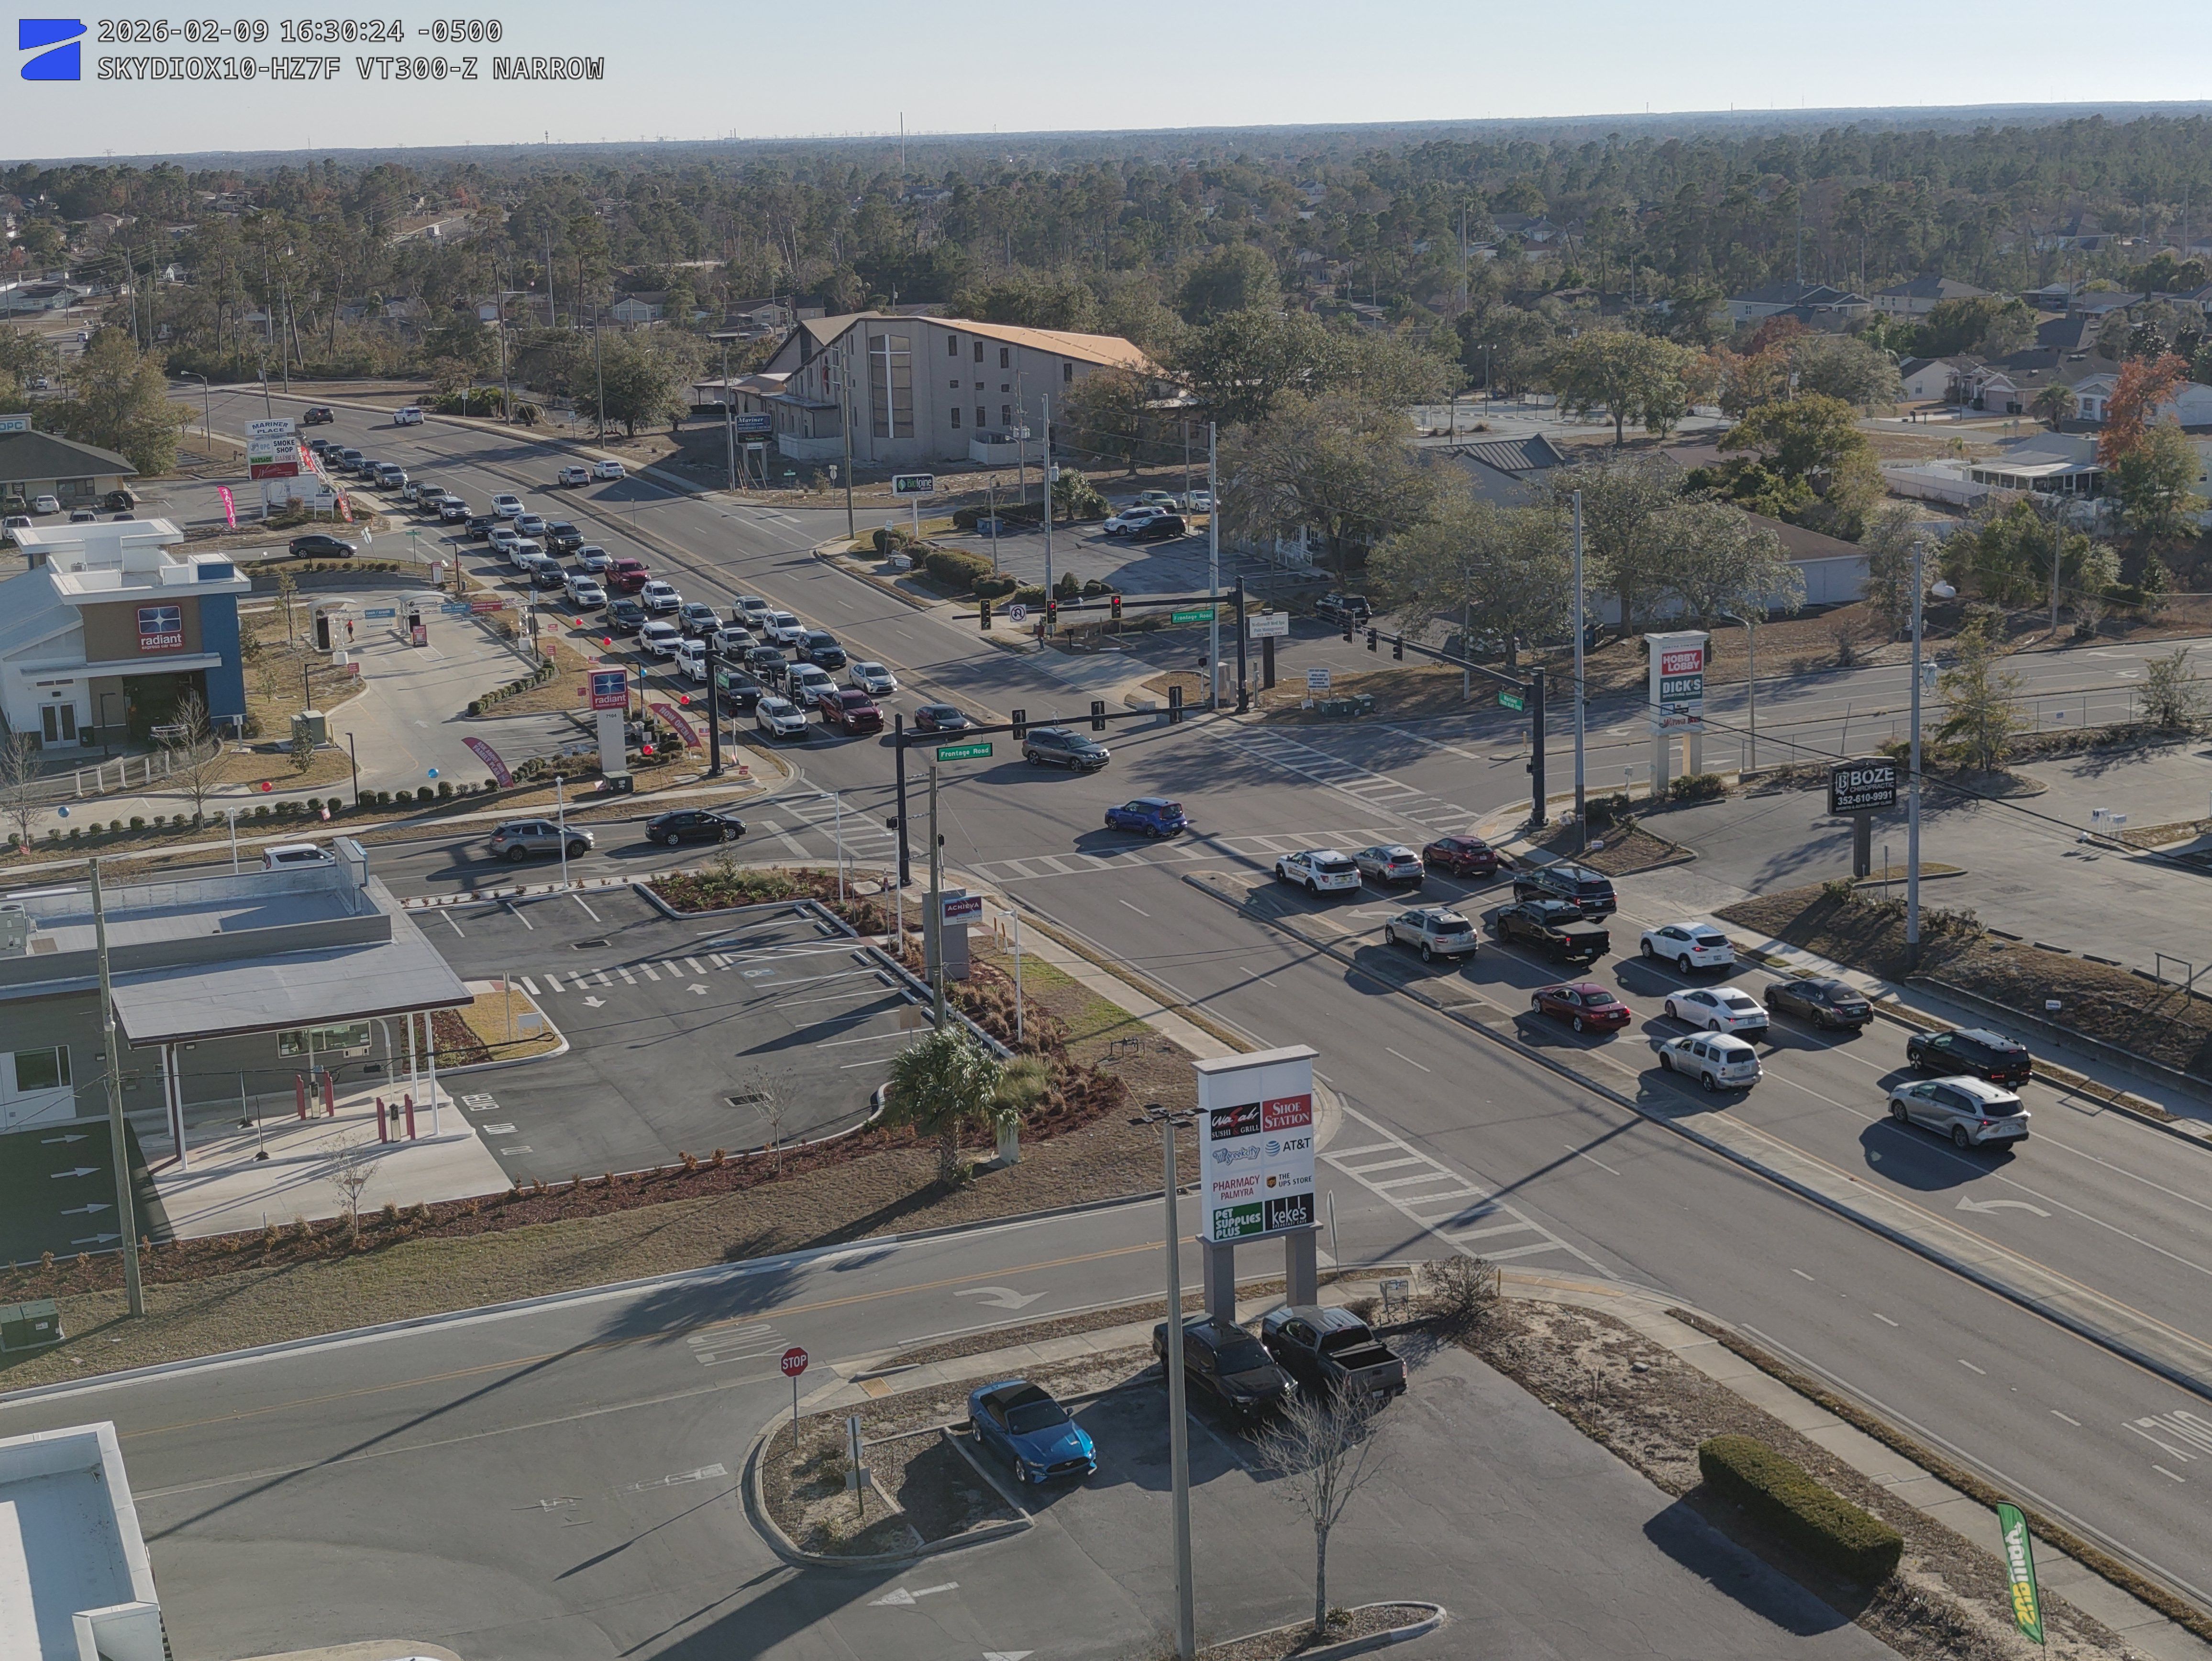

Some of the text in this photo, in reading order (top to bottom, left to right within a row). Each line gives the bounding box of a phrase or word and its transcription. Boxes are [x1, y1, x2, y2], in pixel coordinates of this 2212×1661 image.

[0, 421, 23, 430] OPC
[252, 421, 288, 430] MARINER
[907, 477, 932, 488] BioSpine
[141, 633, 182, 646] radiant
[1663, 653, 1697, 664] HOBBY
[1668, 661, 1700, 672] LOBBY
[1663, 679, 1701, 694] DICK'S
[595, 694, 626, 704] radiant
[659, 706, 676, 721] NOW
[675, 719, 689, 737] OPEN
[472, 744, 501, 776] FAMILY PLAN
[477, 742, 505, 773] ASK ABOUT OUR
[1851, 767, 1894, 786] BOZE
[1850, 782, 1894, 793] CHIROPRACTIC
[1837, 790, 1892, 806] 352-610-9991
[948, 902, 979, 911] ACHIEVA
[461, 1093, 500, 1111] ENTER
[1272, 1102, 1302, 1115] SHOE
[1265, 1112, 1310, 1129] STATION
[482, 1123, 520, 1135] NOT
[1211, 1129, 1231, 1138] SUSHI
[1240, 1124, 1260, 1134] GRILL
[1283, 1137, 1311, 1152] AT&T
[1213, 1174, 1260, 1192] PHARMACY
[1293, 1175, 1312, 1185] STORE
[1221, 1187, 1254, 1200] PALMYRA
[1216, 1208, 1233, 1220] PET
[1216, 1213, 1261, 1229] SUPPLIES
[1216, 1226, 1240, 1239] PLUS
[783, 1354, 807, 1370] STOP
